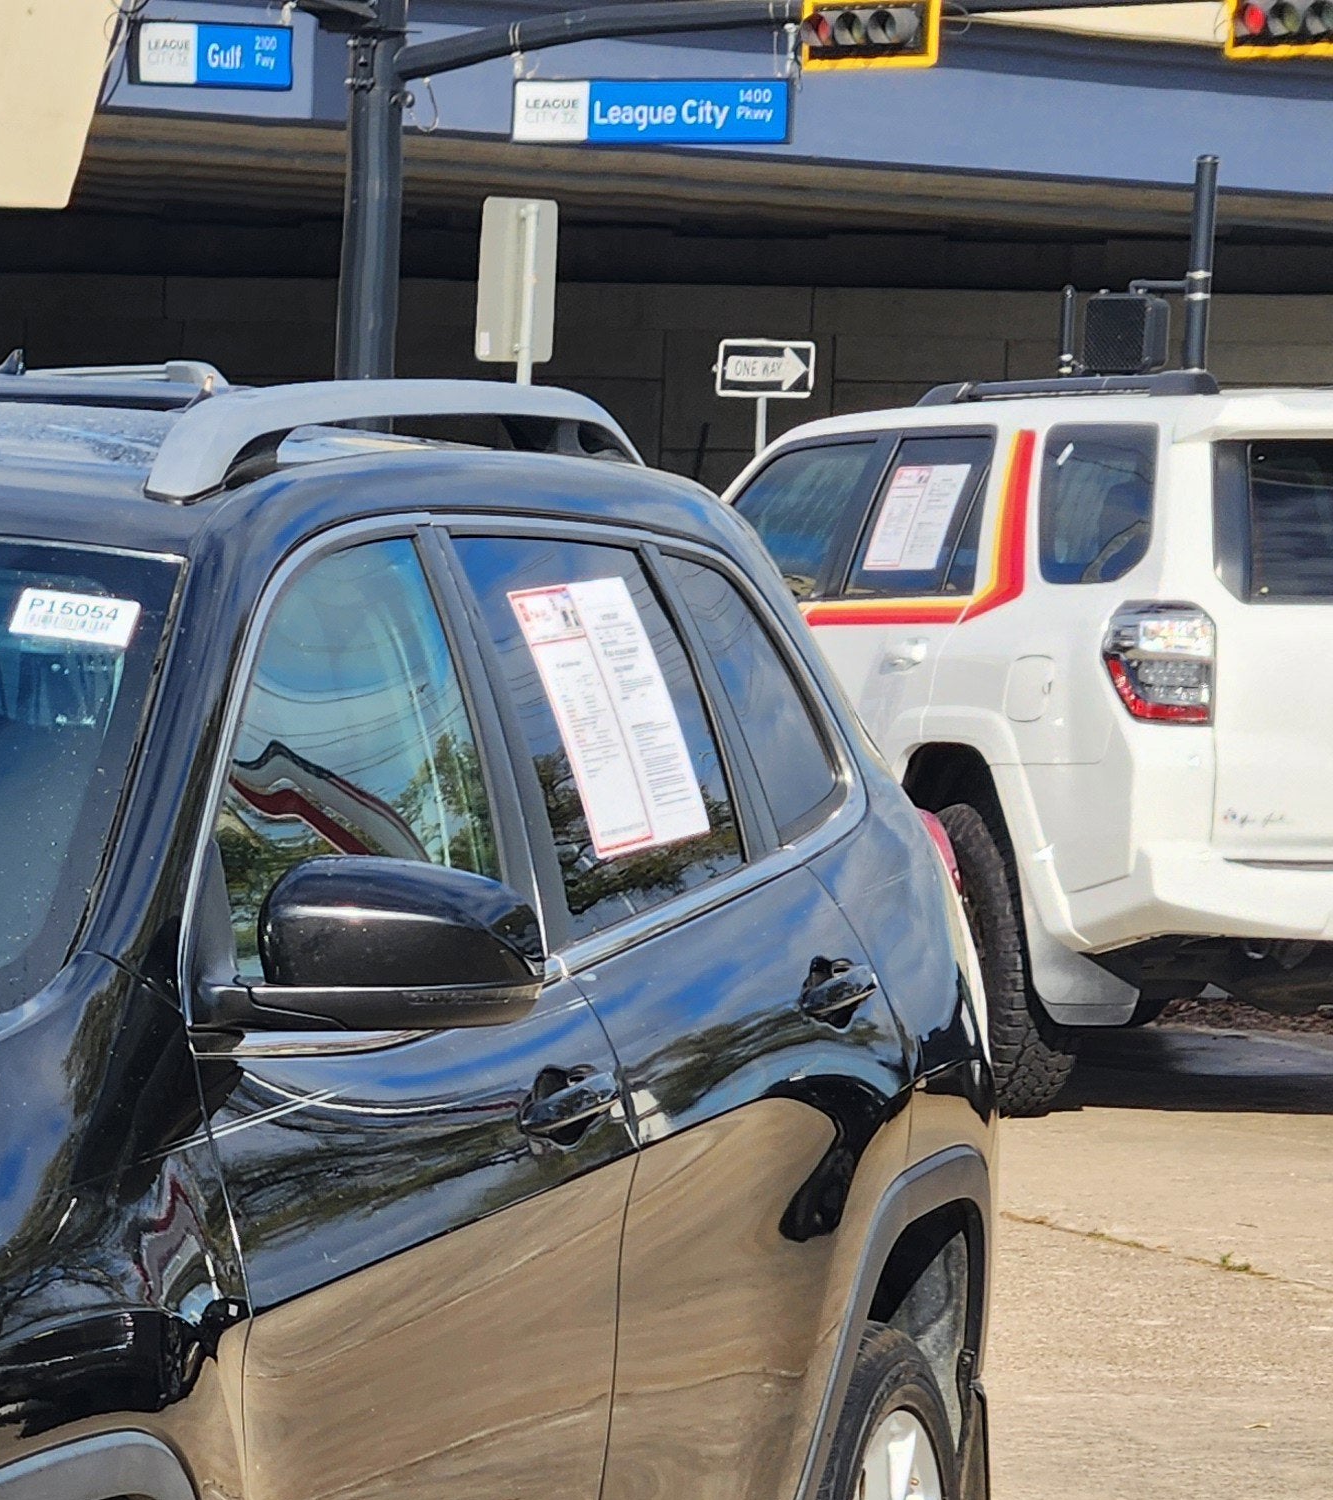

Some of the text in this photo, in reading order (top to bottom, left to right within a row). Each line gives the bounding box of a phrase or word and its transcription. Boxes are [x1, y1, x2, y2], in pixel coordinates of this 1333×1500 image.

[147, 39, 191, 50] LEAGUE
[254, 35, 278, 50] 2100
[206, 43, 242, 69] Gulf
[254, 53, 275, 70] Fwy
[524, 98, 579, 109] LEAGUE
[738, 88, 772, 103] 1400
[593, 99, 730, 131] League City
[735, 107, 773, 122] Pkwy
[734, 360, 784, 377] ONE WAY
[28, 598, 119, 621] P15054
